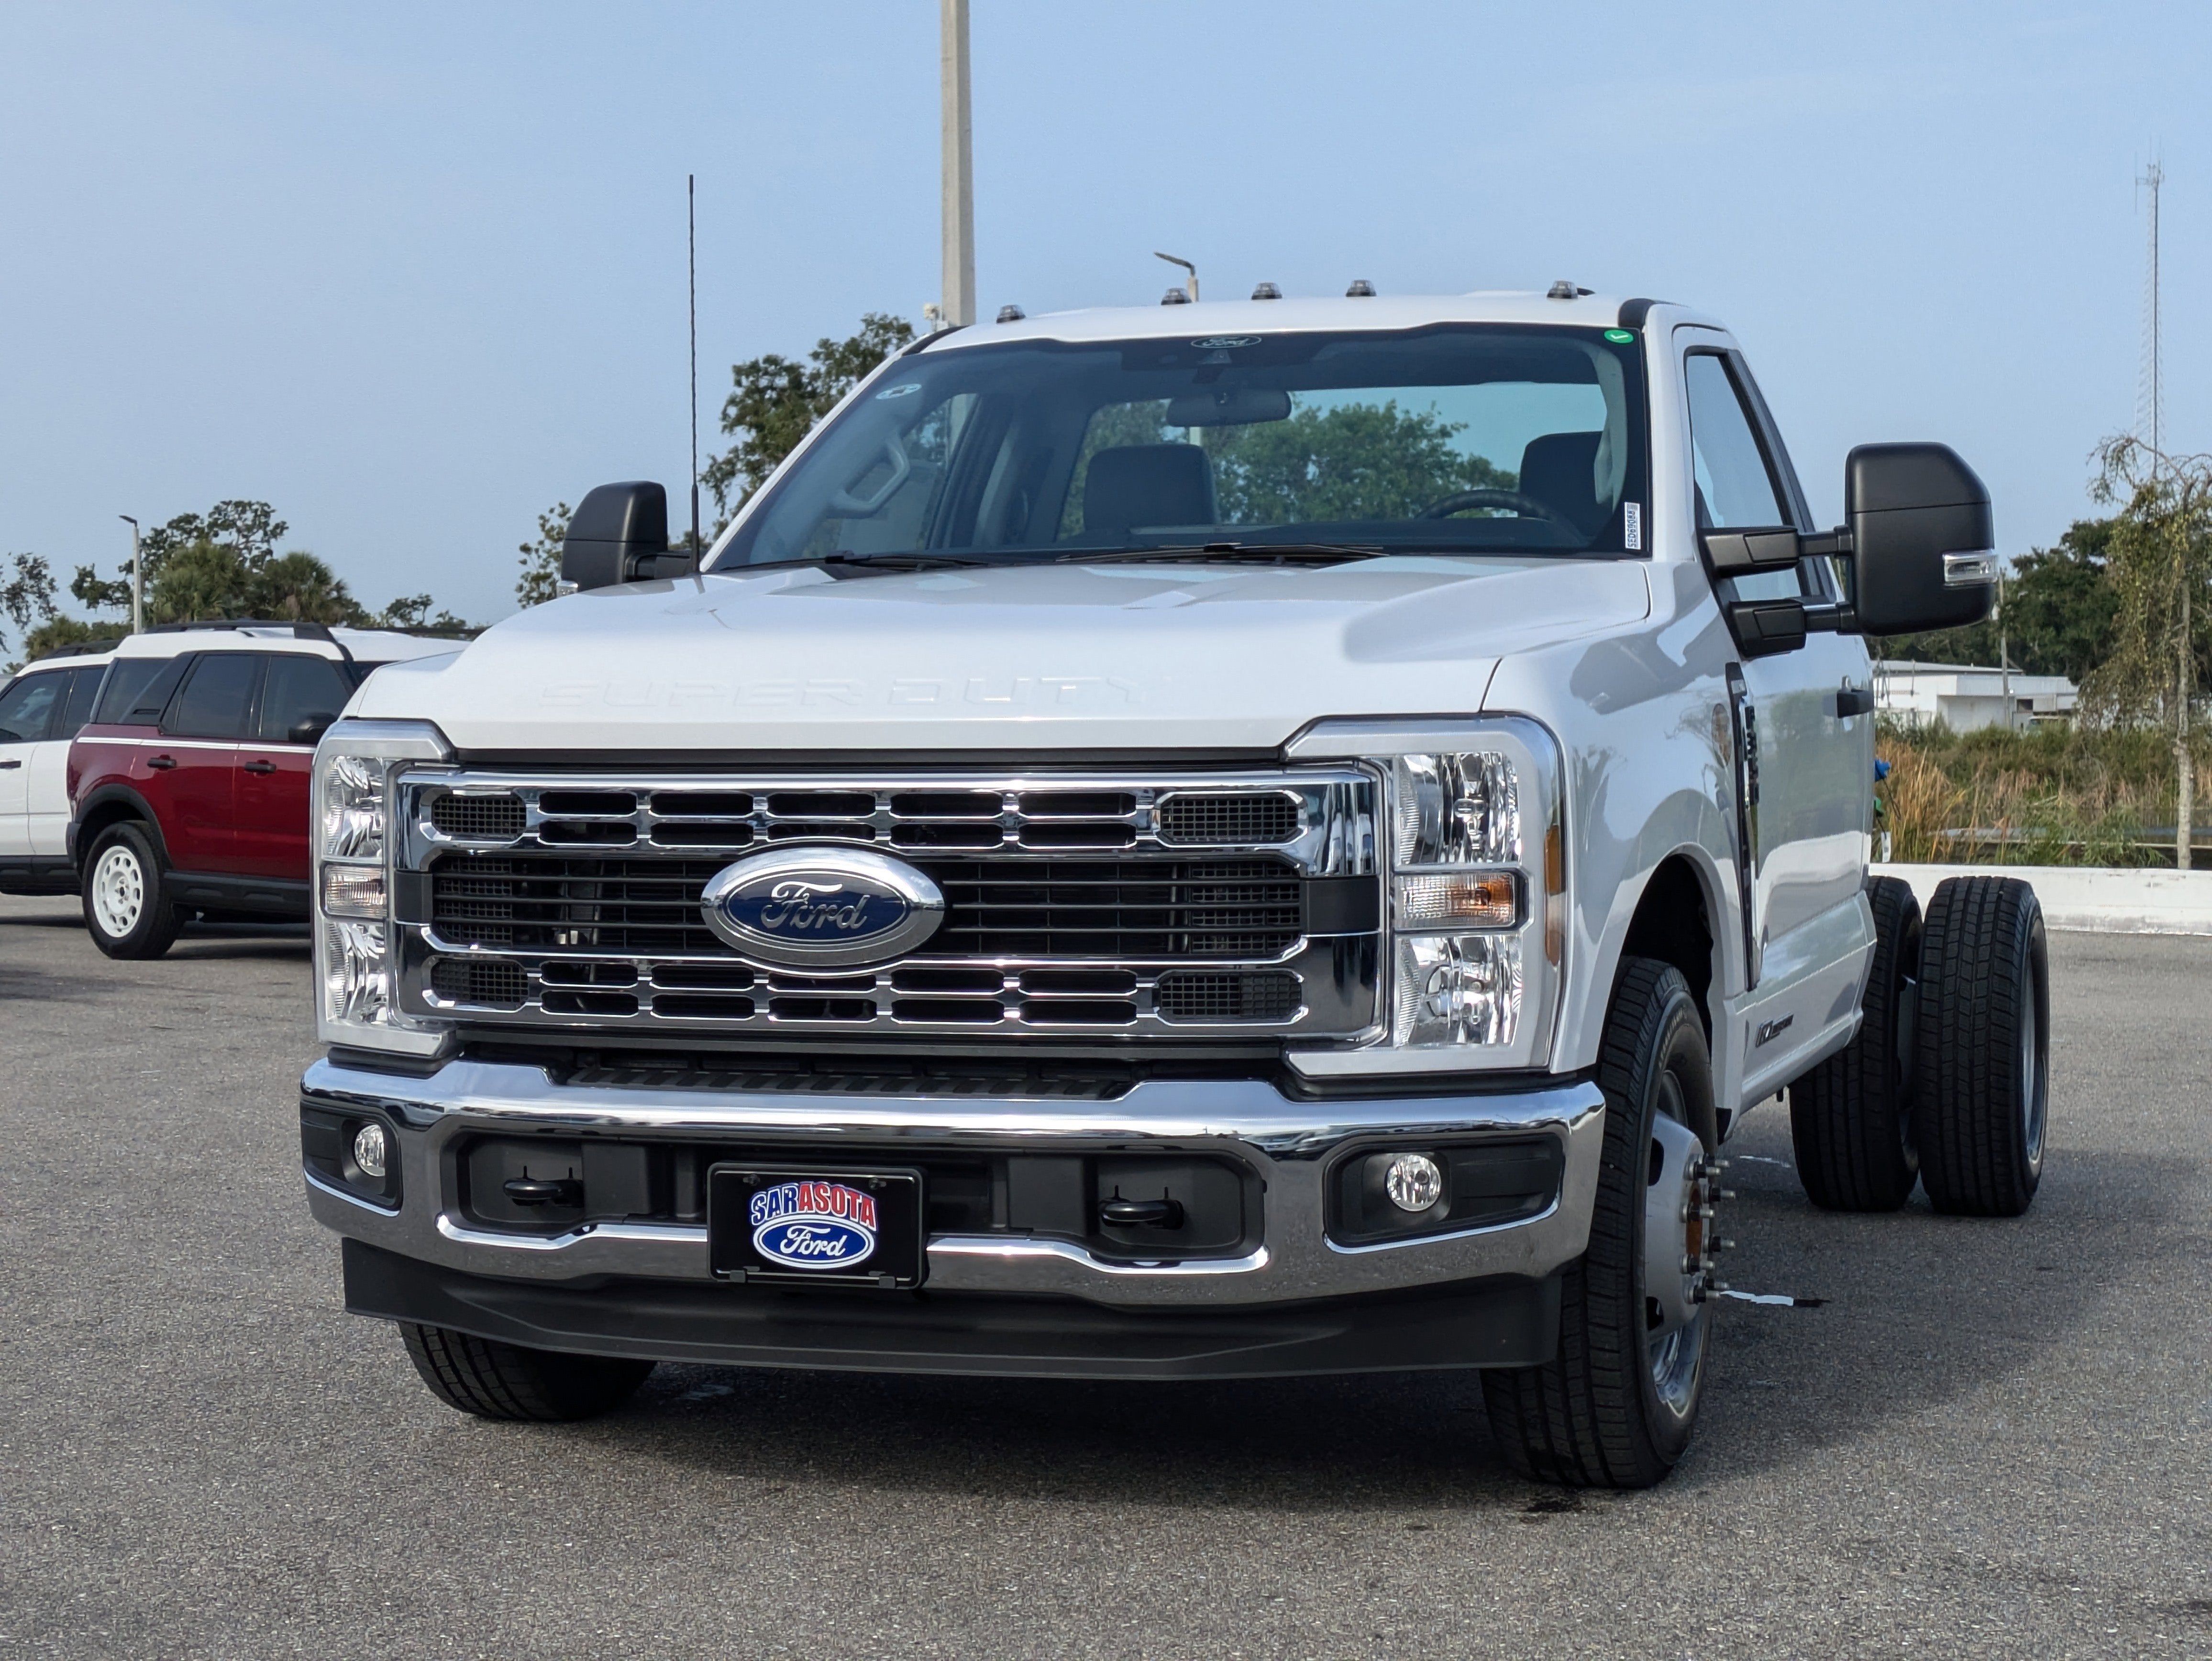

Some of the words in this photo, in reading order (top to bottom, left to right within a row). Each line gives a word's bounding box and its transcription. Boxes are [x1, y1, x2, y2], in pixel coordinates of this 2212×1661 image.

[538, 677, 862, 705] SUPER
[888, 675, 1146, 704] DUTY
[761, 881, 870, 930] Ford
[750, 1181, 877, 1232] SARASOTA
[780, 1225, 847, 1257] Ford
